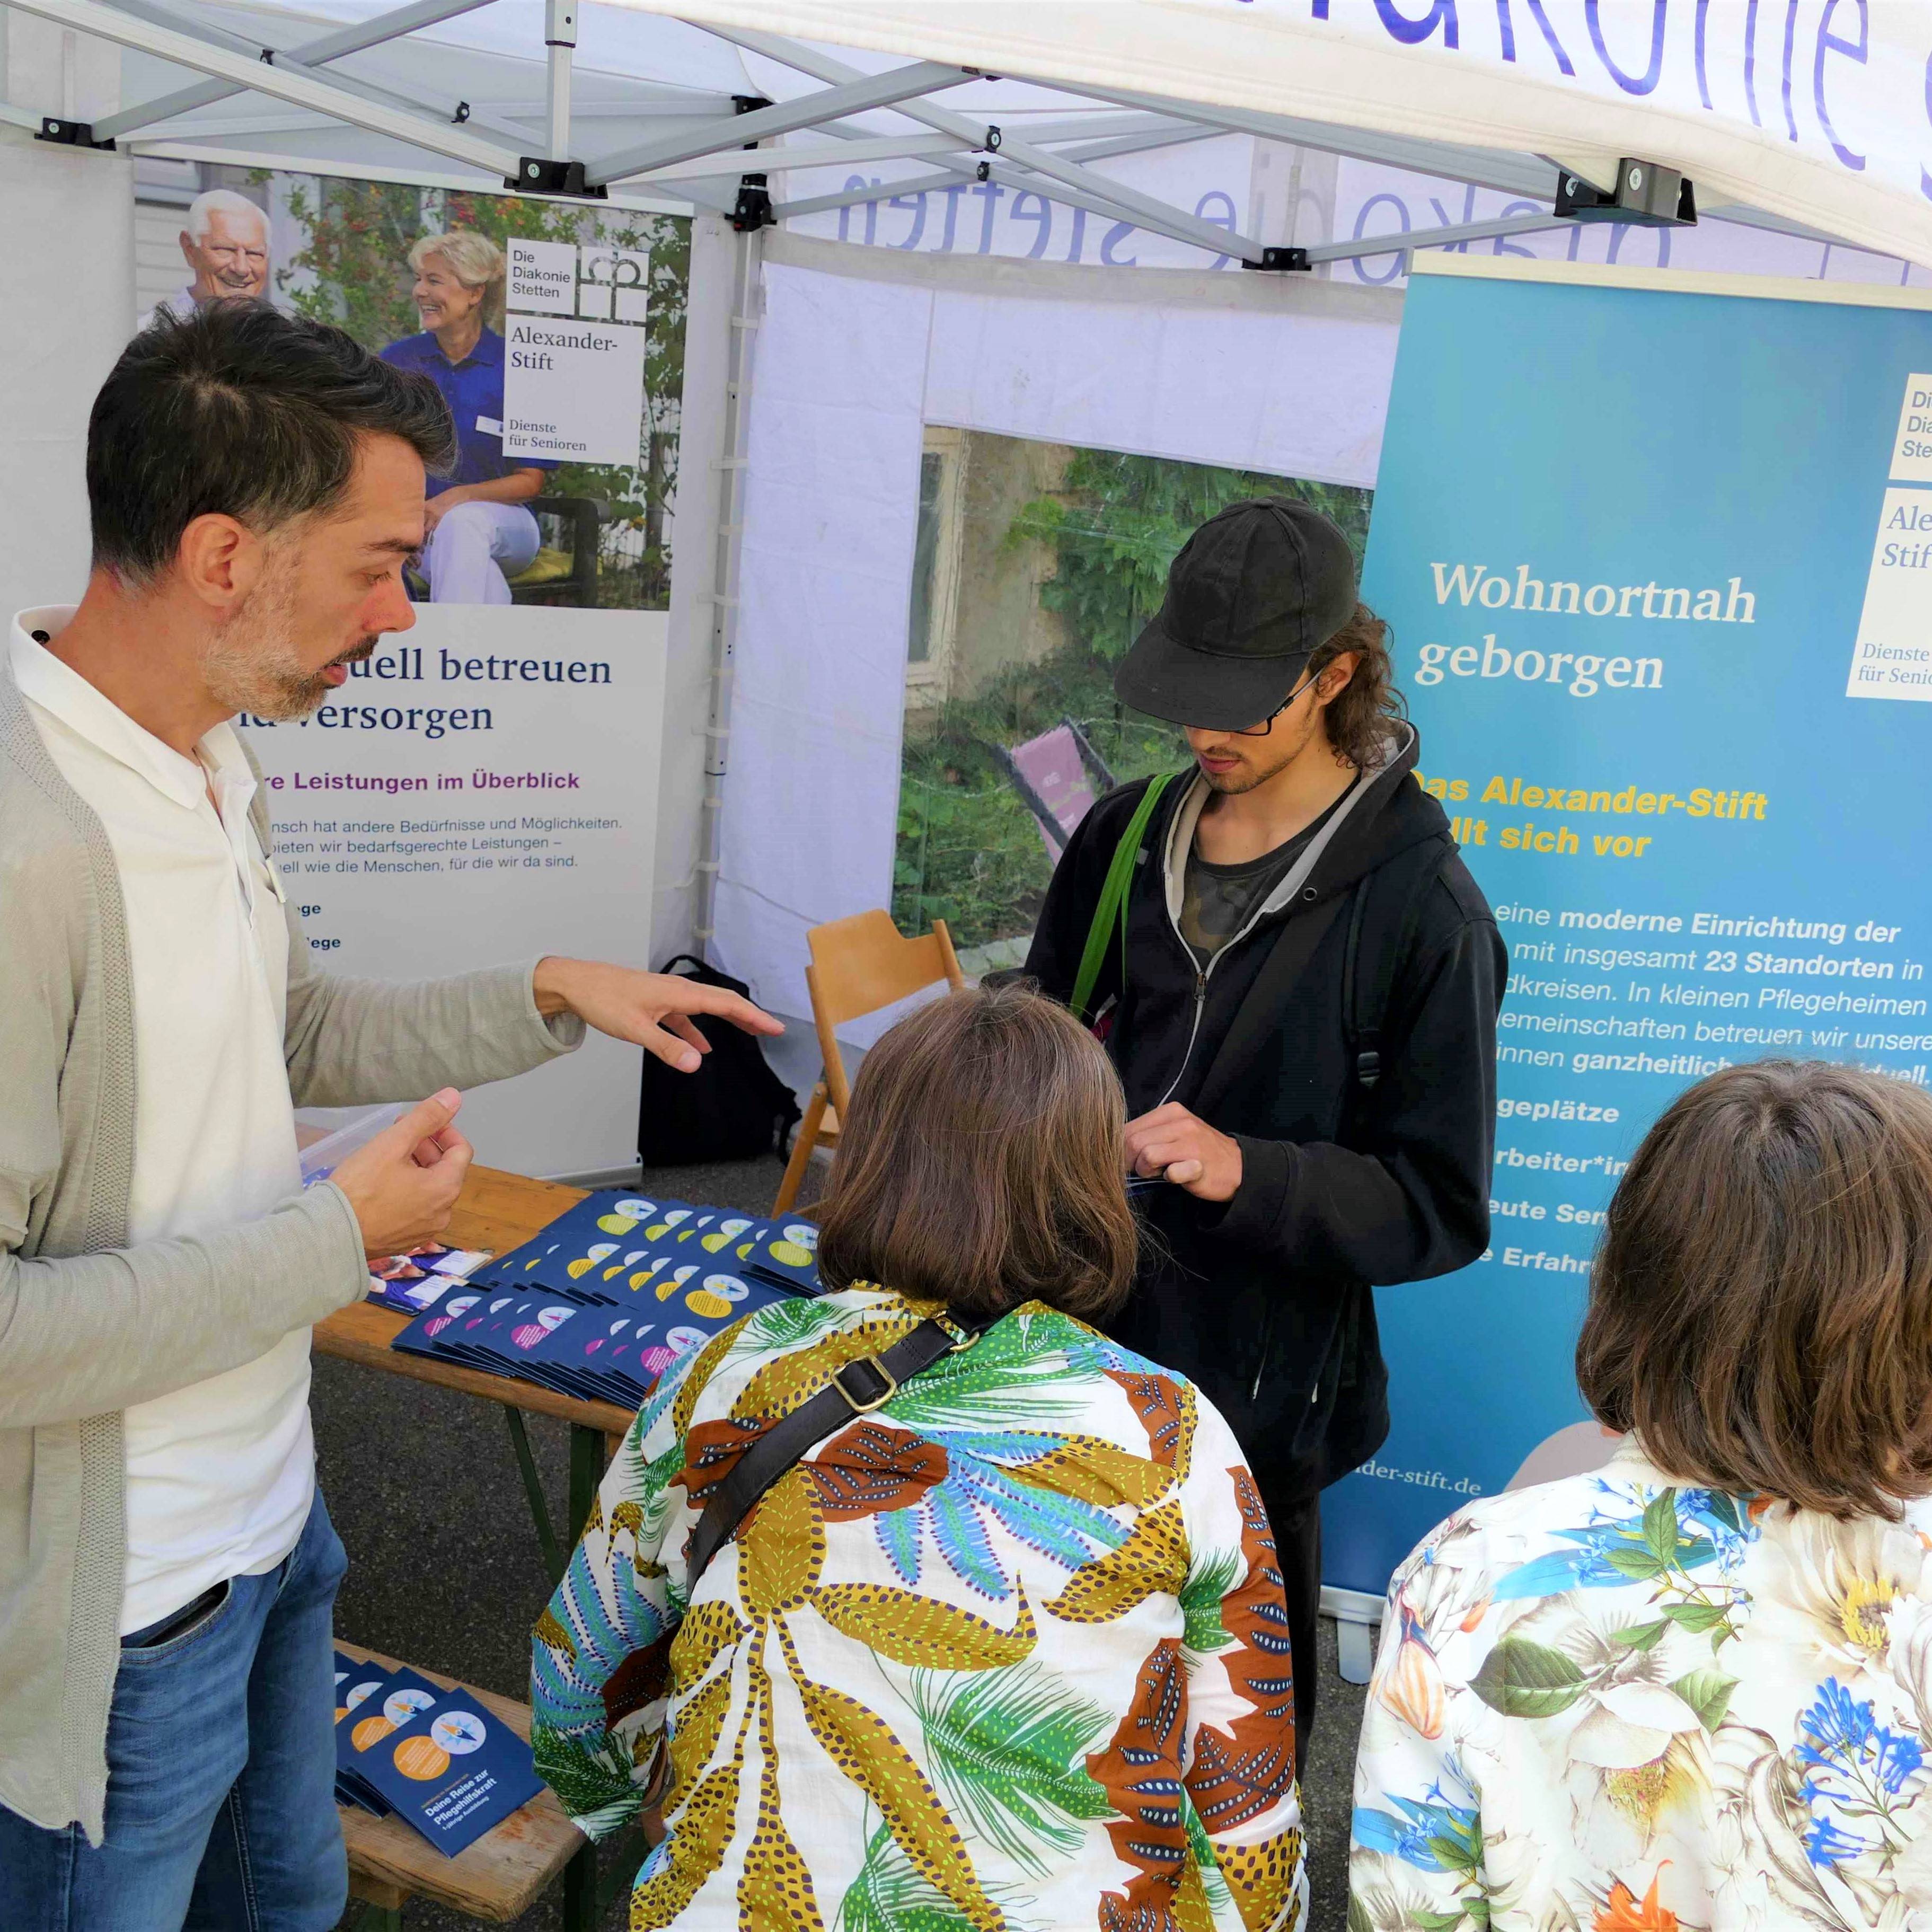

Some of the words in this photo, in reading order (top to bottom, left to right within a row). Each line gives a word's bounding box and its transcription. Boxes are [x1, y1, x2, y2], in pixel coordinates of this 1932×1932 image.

[513, 250, 534, 263] Die
[513, 267, 570, 283] Diakonie
[512, 283, 560, 298] Stetten
[510, 327, 618, 351] Alexander-
[511, 351, 554, 370] Stift
[1912, 391, 1932, 409] Di
[509, 420, 557, 433] Dienste
[509, 435, 527, 446] für
[531, 438, 587, 451] Senioren
[1430, 562, 1756, 623] Wohnortnah
[1862, 643, 1930, 661] Dienste
[439, 649, 612, 684] betreuen
[1415, 634, 1663, 697] geborgen
[1857, 665, 1885, 682] für
[300, 705, 493, 739] ersorgen
[294, 772, 428, 793] Leistungen
[437, 774, 463, 790] im
[472, 769, 580, 790] Überblick
[1480, 776, 1768, 821] Alexander-Stift
[271, 821, 307, 833] nsch
[313, 821, 337, 833] hat
[342, 821, 395, 833] andere
[400, 820, 485, 833] Bedürfnisse
[490, 818, 516, 830] und
[522, 817, 622, 832] Möglichkeiten.
[320, 841, 342, 852] wir
[347, 838, 467, 855] bedarfsgerechte
[472, 838, 549, 851] Leistungen
[1500, 823, 1579, 854] sich
[1593, 835, 1652, 857] vor
[305, 860, 330, 872] wie
[336, 860, 358, 872] die
[364, 859, 444, 874] Menschen,
[449, 857, 467, 870] für
[472, 856, 493, 869] die
[498, 855, 519, 868] wir
[523, 855, 541, 868] da
[545, 855, 578, 867] sind.
[1495, 902, 1550, 925] eine
[1559, 909, 1682, 933] moderne
[1691, 913, 1846, 945] Einrichtung
[1855, 921, 1901, 943] der
[1514, 941, 1556, 963] mit
[1564, 943, 1697, 971] insgesamt
[1704, 950, 1737, 972] 23
[1744, 952, 1894, 979] Standorten
[1902, 959, 1923, 981] in
[1628, 982, 1651, 1003] In
[1660, 983, 1749, 1008] kleinen
[1758, 988, 1927, 1016] Pflegeheimen
[1496, 1013, 1686, 1040] emeinschaften
[1695, 1021, 1802, 1046] betreuen
[1811, 1027, 1849, 1048] wir
[1856, 1033, 1932, 1051] unsere
[425, 1797, 452, 1817] Deine
[449, 1780, 475, 1799] Reise
[474, 1769, 489, 1783] zur
[434, 1778, 497, 1825] Pflegehilfskraft
